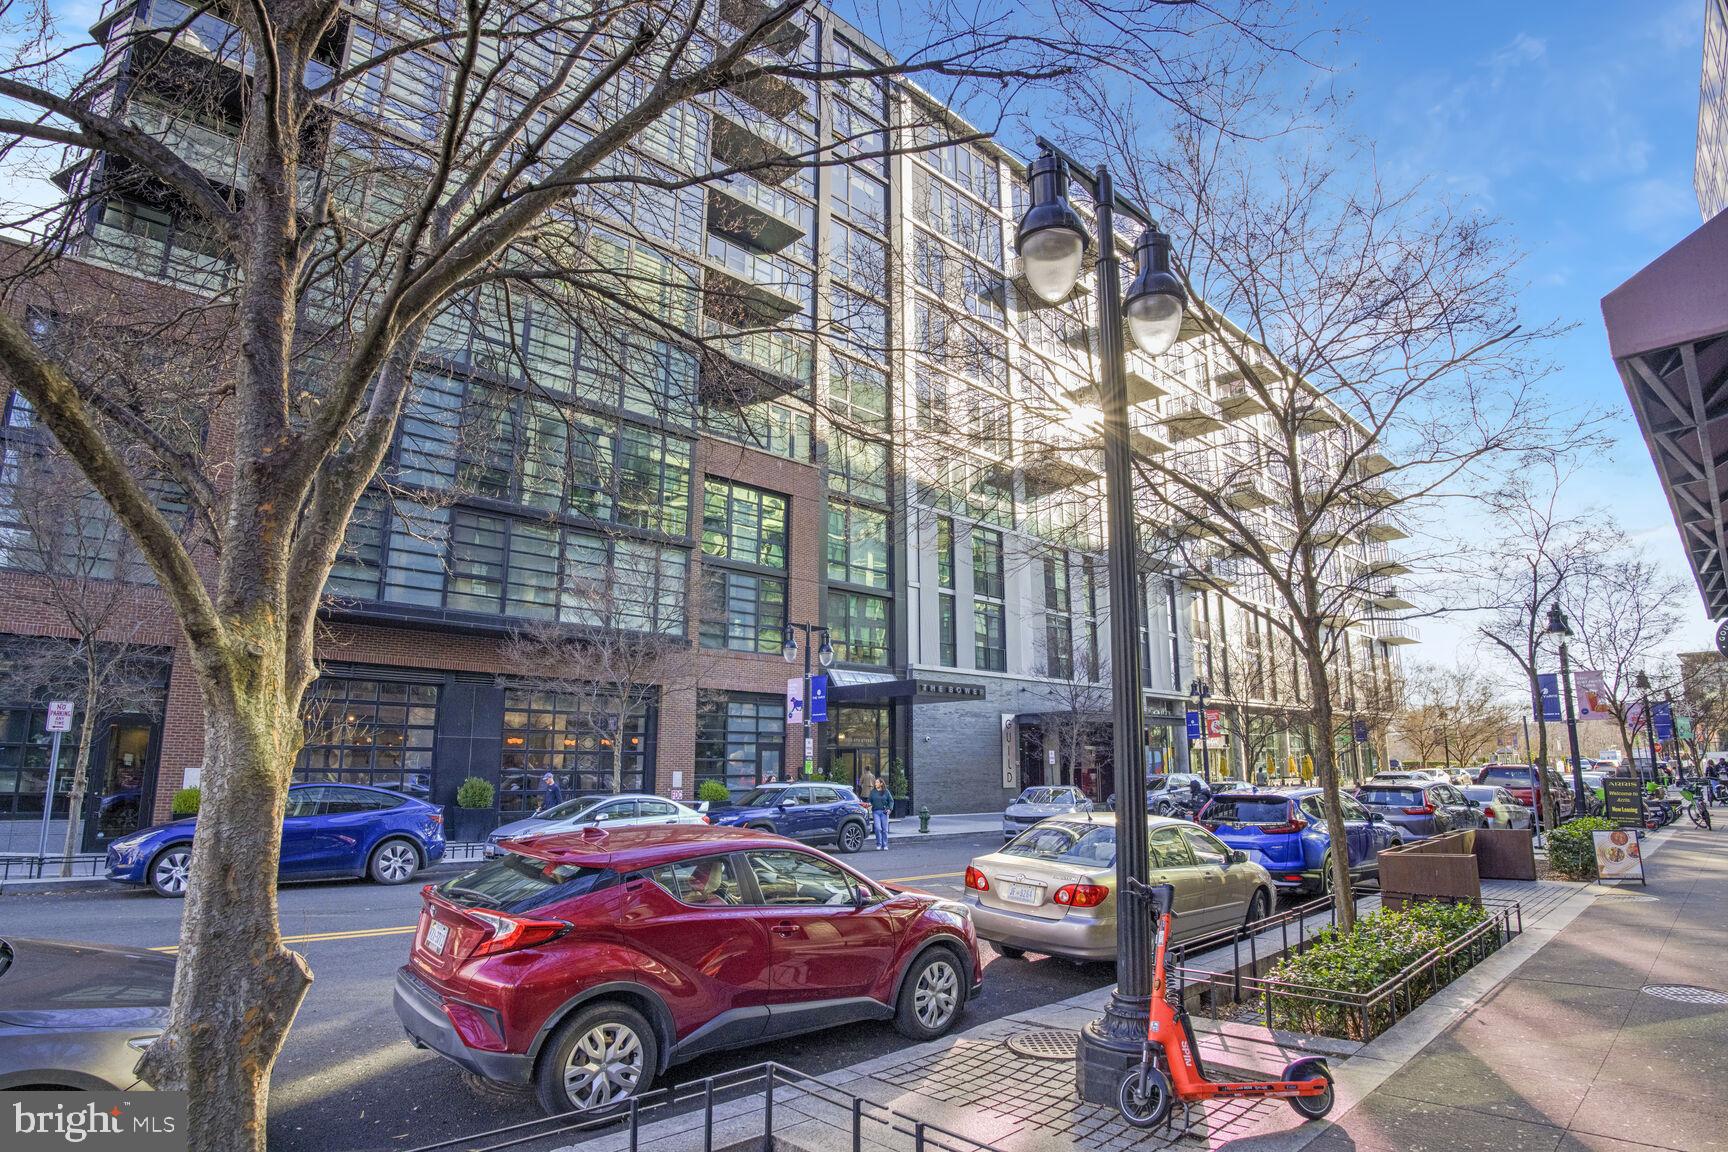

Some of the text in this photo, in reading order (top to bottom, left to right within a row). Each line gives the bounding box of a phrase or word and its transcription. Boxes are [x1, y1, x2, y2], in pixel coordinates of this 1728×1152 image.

[920, 683, 985, 696] THE BOWER
[56, 703, 67, 711] NO
[1005, 719, 1013, 783] GUILD
[1181, 1040, 1192, 1067] SPIN
